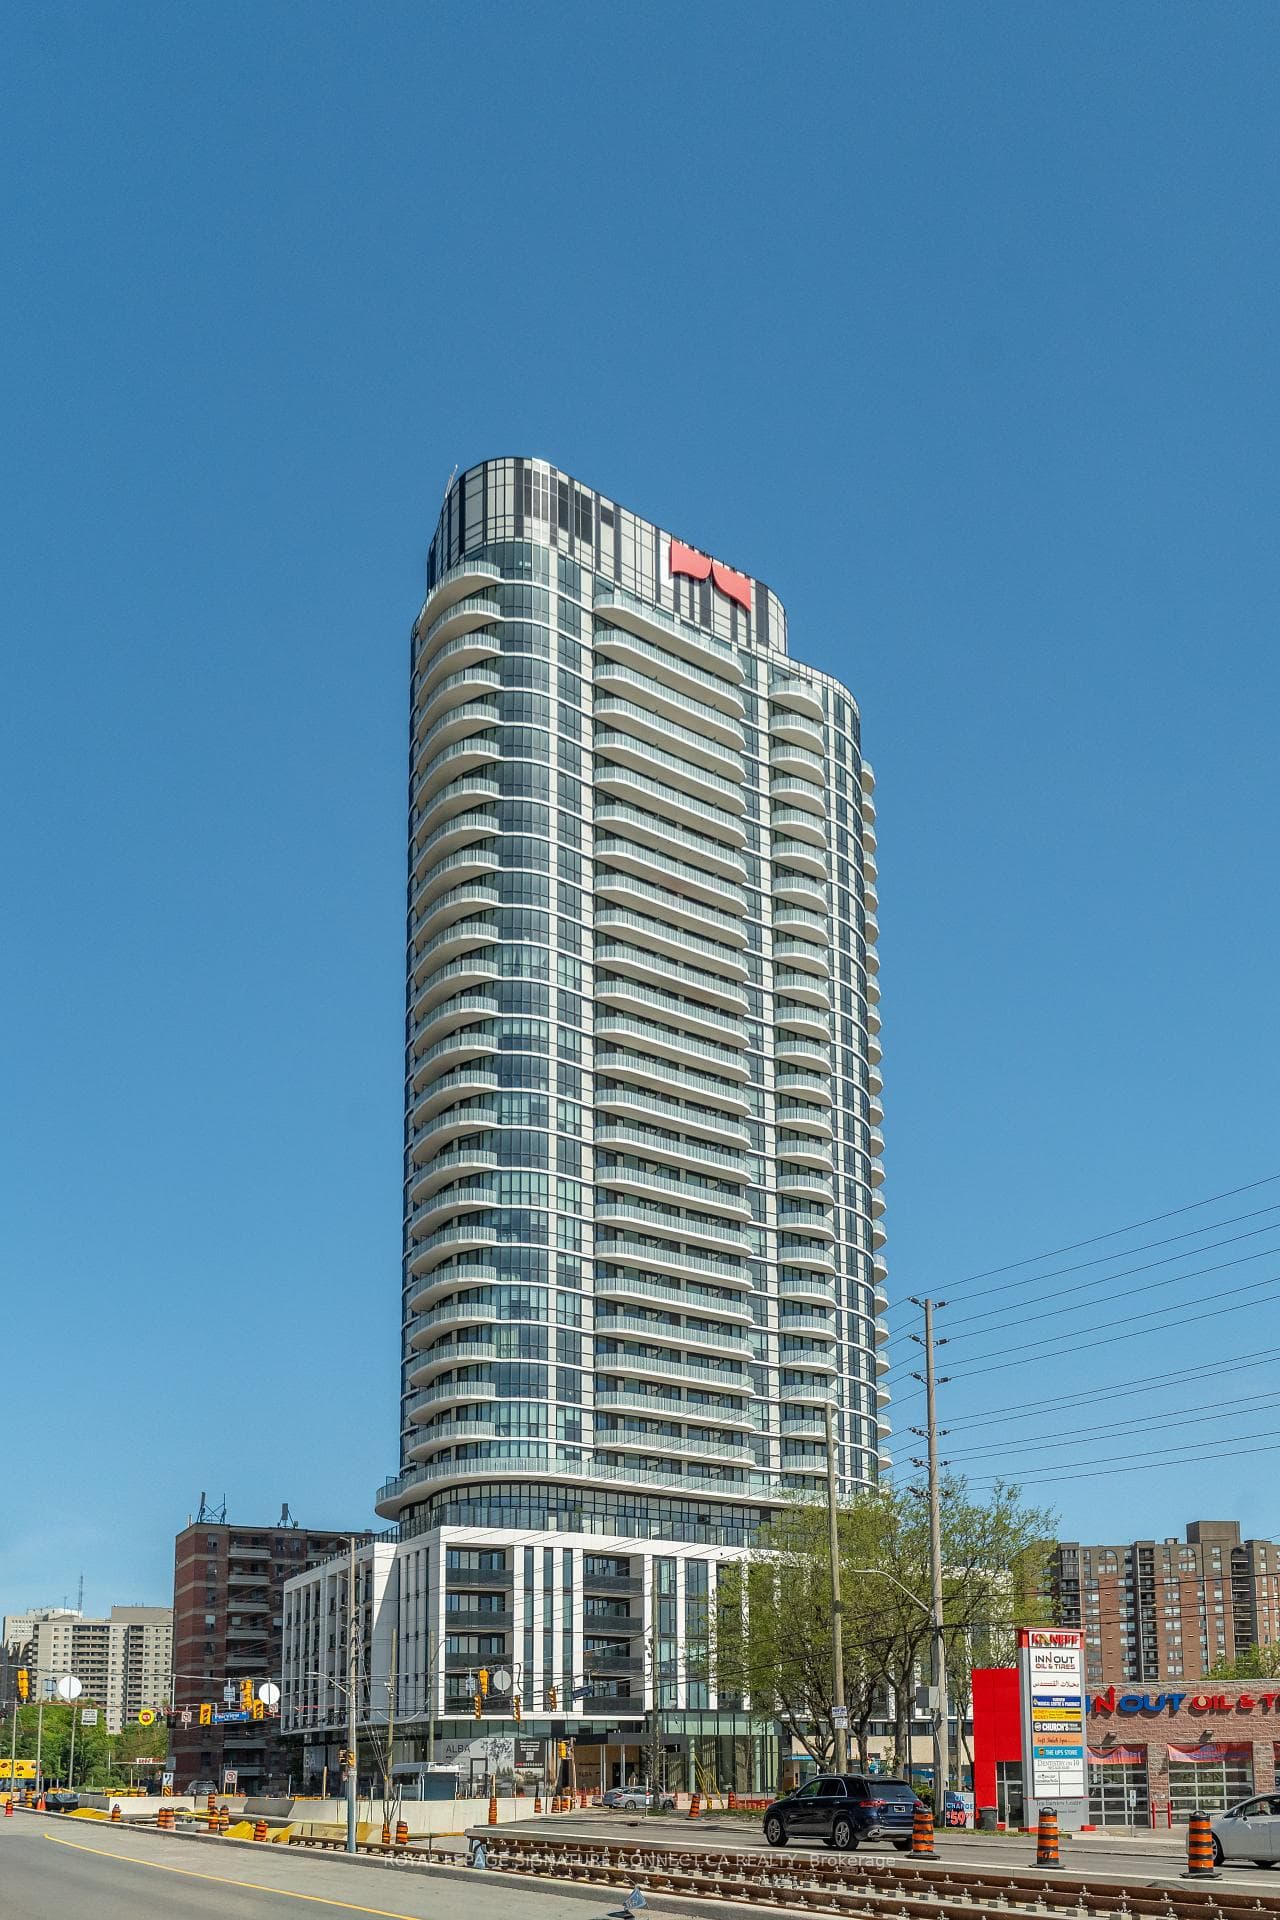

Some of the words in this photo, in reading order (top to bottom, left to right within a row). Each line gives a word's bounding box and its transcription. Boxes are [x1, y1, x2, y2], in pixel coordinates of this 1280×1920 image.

[1032, 1633, 1079, 1644] KANEFF
[1192, 1695, 1234, 1711] OIL
[1240, 1694, 1256, 1709] &
[1261, 1693, 1280, 1709] T
[446, 1744, 471, 1753] ALBA
